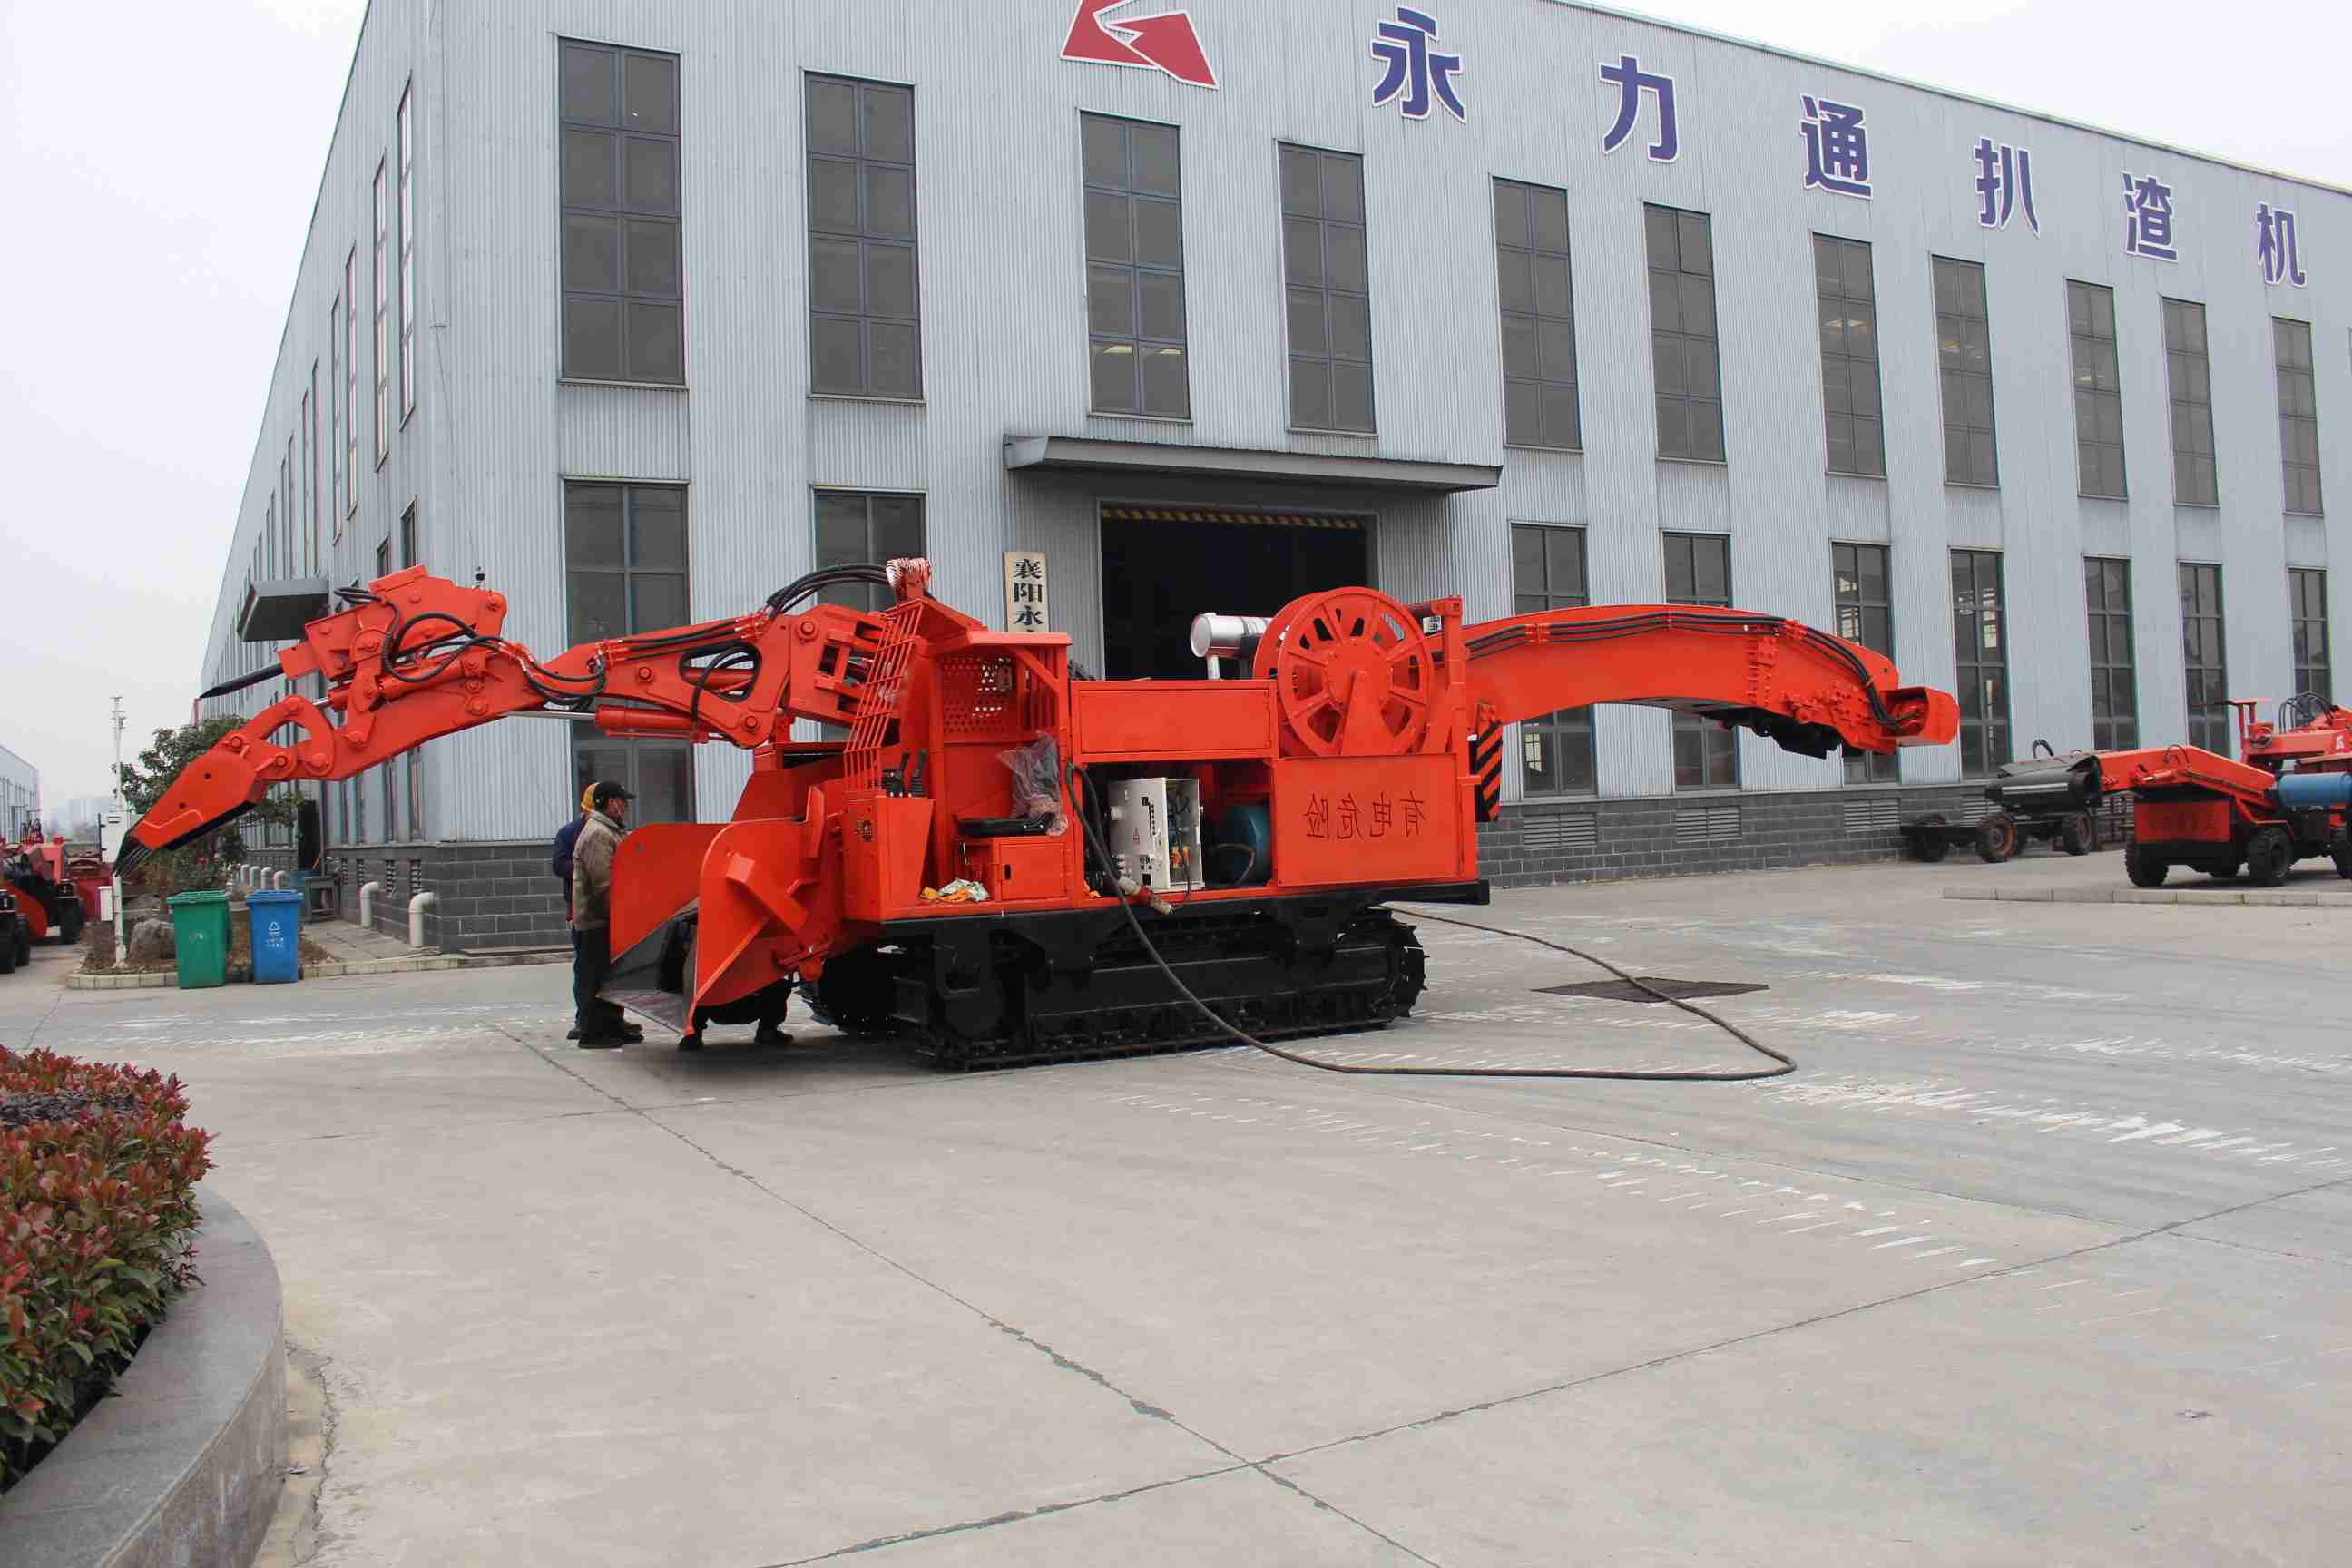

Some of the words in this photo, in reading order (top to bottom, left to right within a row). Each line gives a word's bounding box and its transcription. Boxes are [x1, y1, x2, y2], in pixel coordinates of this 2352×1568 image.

[1371, 7, 2306, 287] 永力通扒渣机
[1013, 559, 1044, 632] 襄阳永
